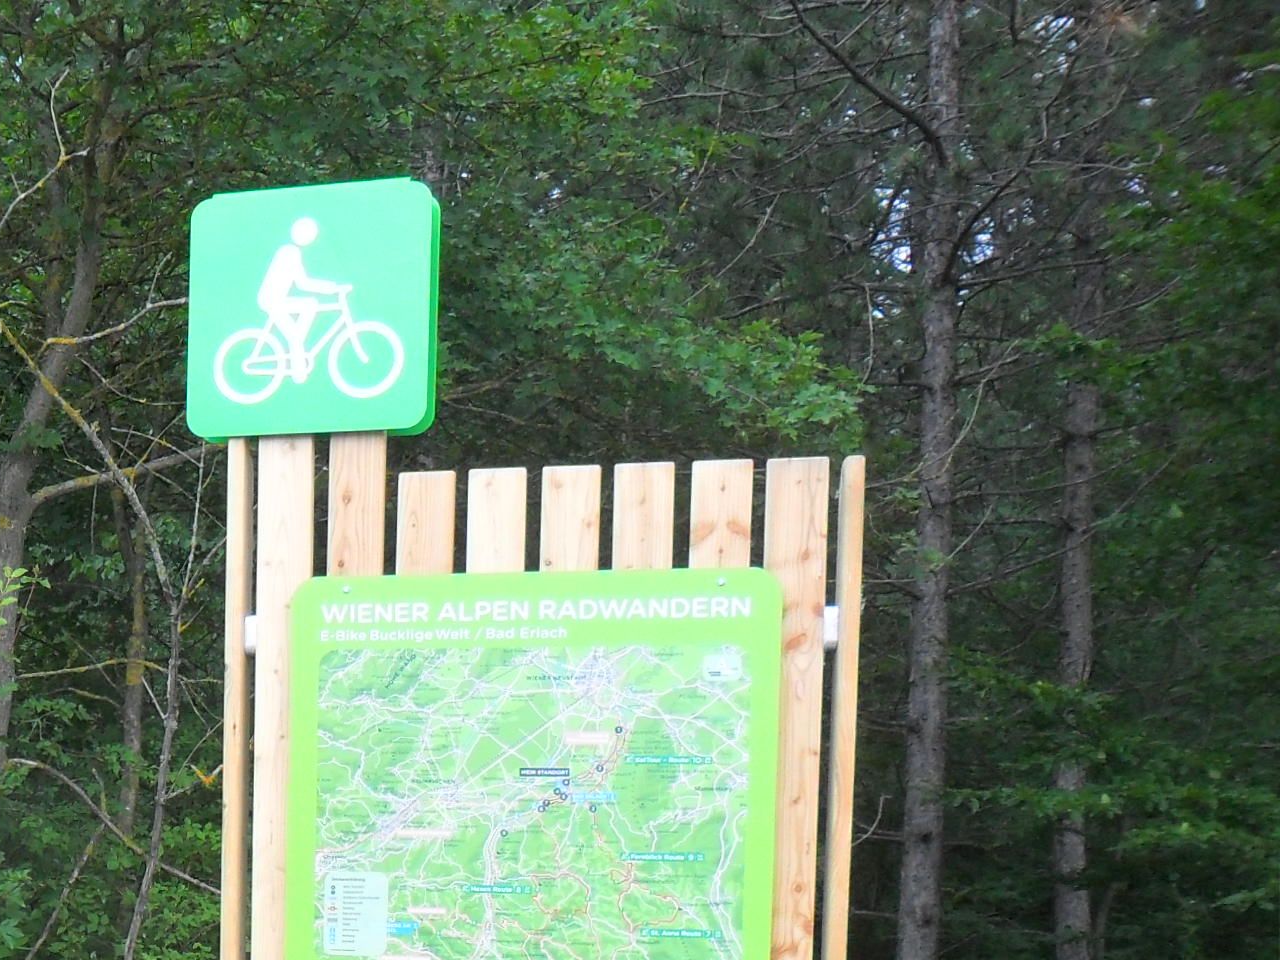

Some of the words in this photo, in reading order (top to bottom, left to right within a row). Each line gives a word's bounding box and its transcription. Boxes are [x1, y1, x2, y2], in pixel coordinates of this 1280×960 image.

[320, 603, 429, 624] WIENER
[438, 601, 530, 622] ALPEN
[539, 597, 752, 620] RADWANDERN
[320, 630, 367, 642] E-Bike
[369, 628, 433, 643] Bucklige
[434, 629, 470, 641] Welt
[485, 627, 515, 640] Bad
[519, 626, 568, 640] Erlach
